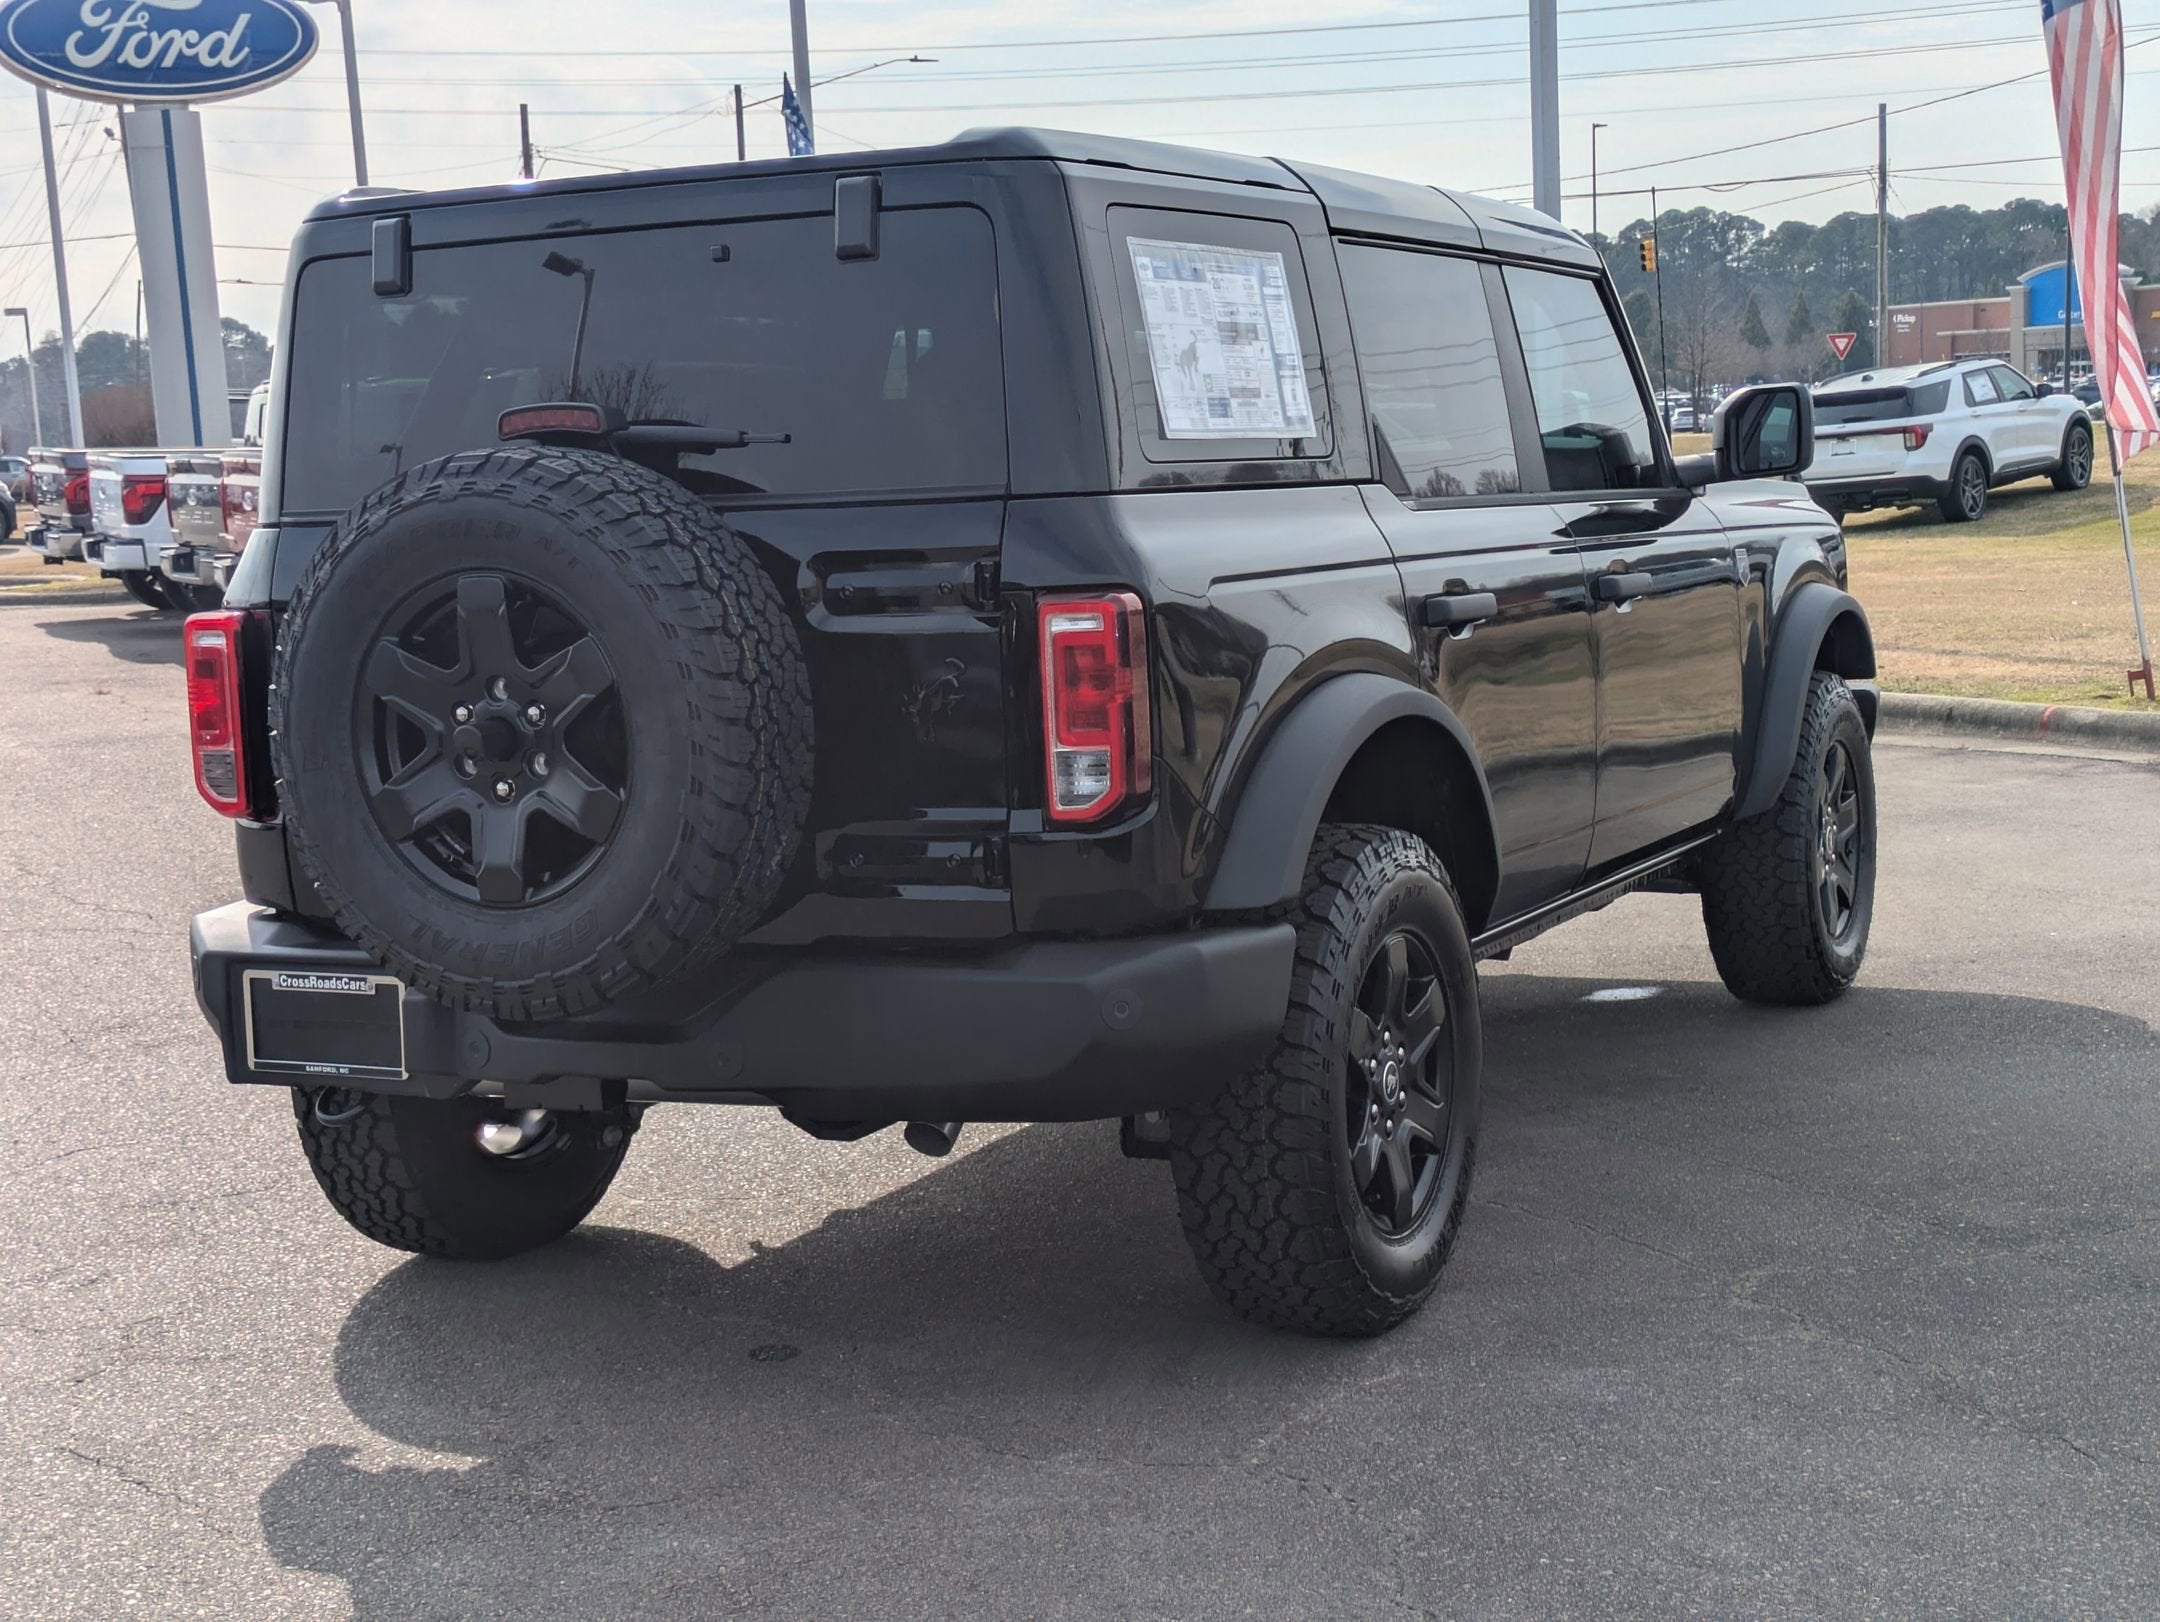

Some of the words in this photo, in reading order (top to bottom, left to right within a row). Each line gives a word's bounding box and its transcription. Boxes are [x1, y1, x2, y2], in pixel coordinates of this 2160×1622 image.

[65, 0, 252, 68] Ford
[408, 908, 599, 964] GENERAL
[280, 975, 366, 990] CrossRoadsCars
